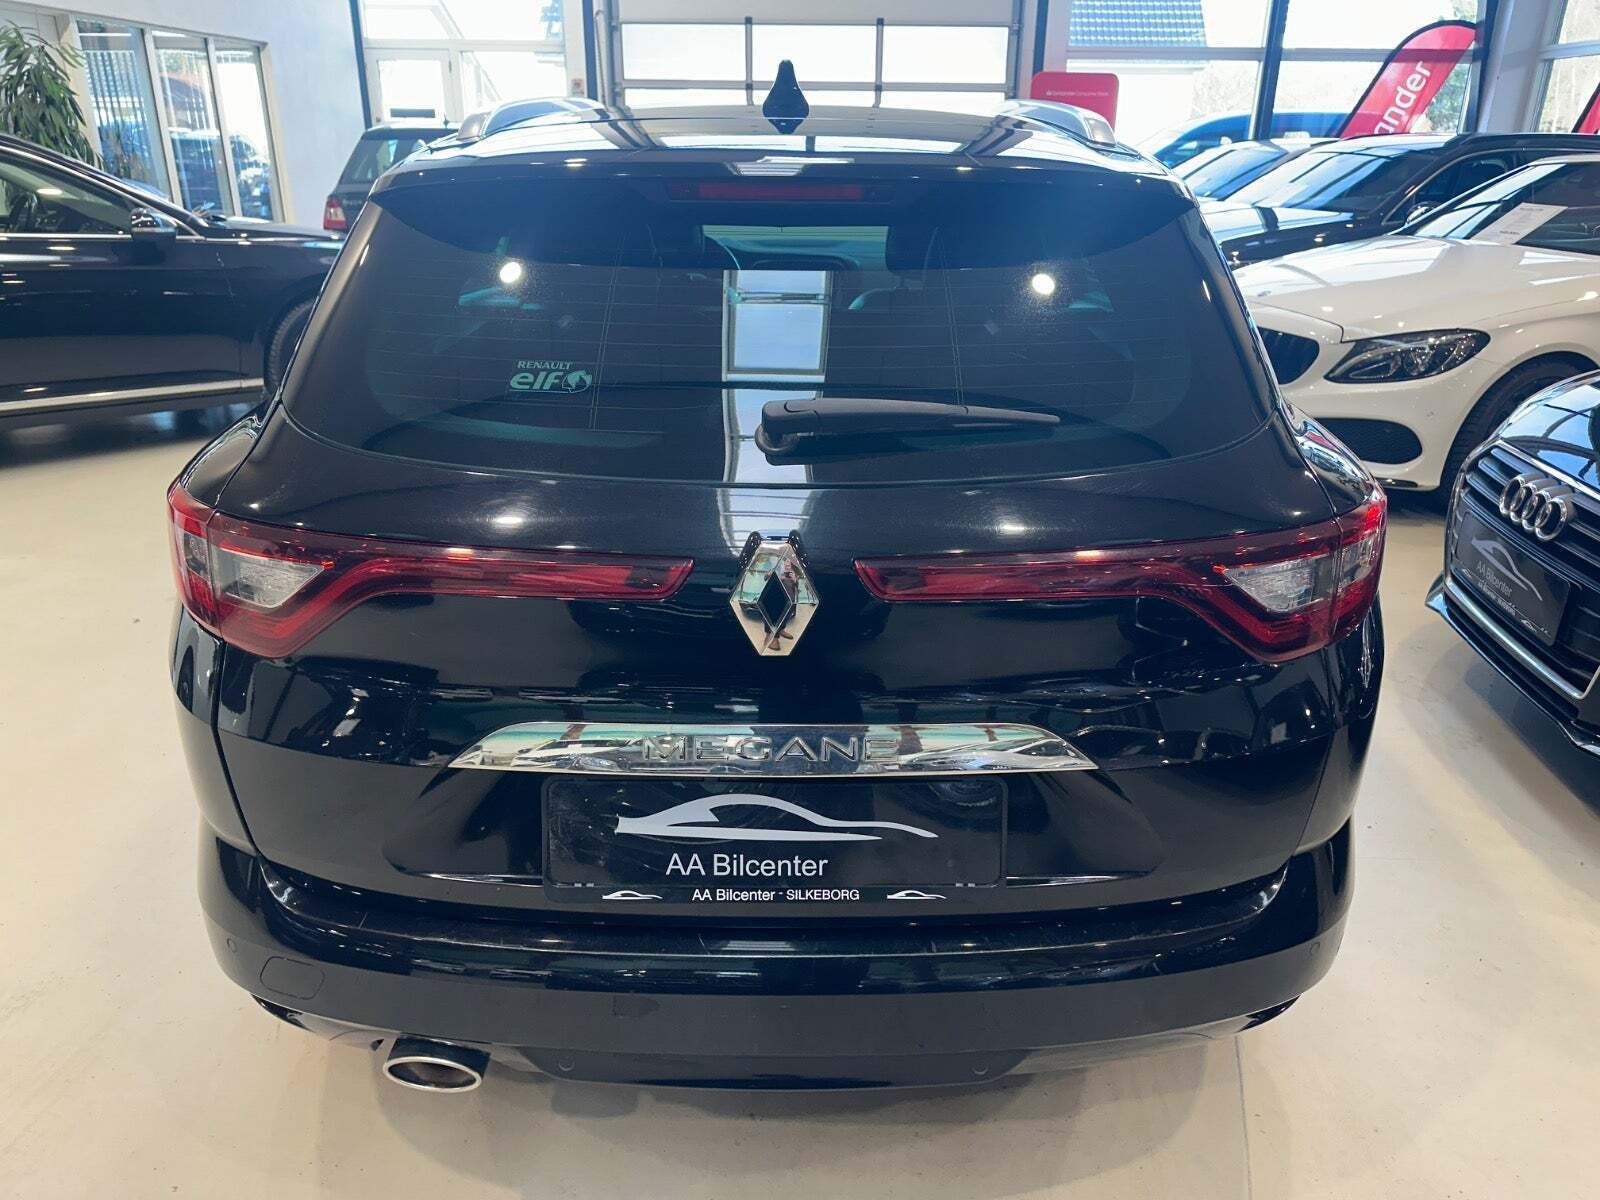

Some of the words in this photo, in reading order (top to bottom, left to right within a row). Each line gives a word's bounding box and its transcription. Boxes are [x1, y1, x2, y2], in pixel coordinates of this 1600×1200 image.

[517, 360, 574, 369] RENAULT
[509, 371, 564, 390] elf
[643, 736, 900, 762] MEGANE
[665, 852, 706, 876] AA
[713, 853, 829, 877] Bilcenter
[691, 888, 713, 901] AA
[716, 888, 776, 901] Bilcenter
[785, 889, 860, 901] SILKEBORG
